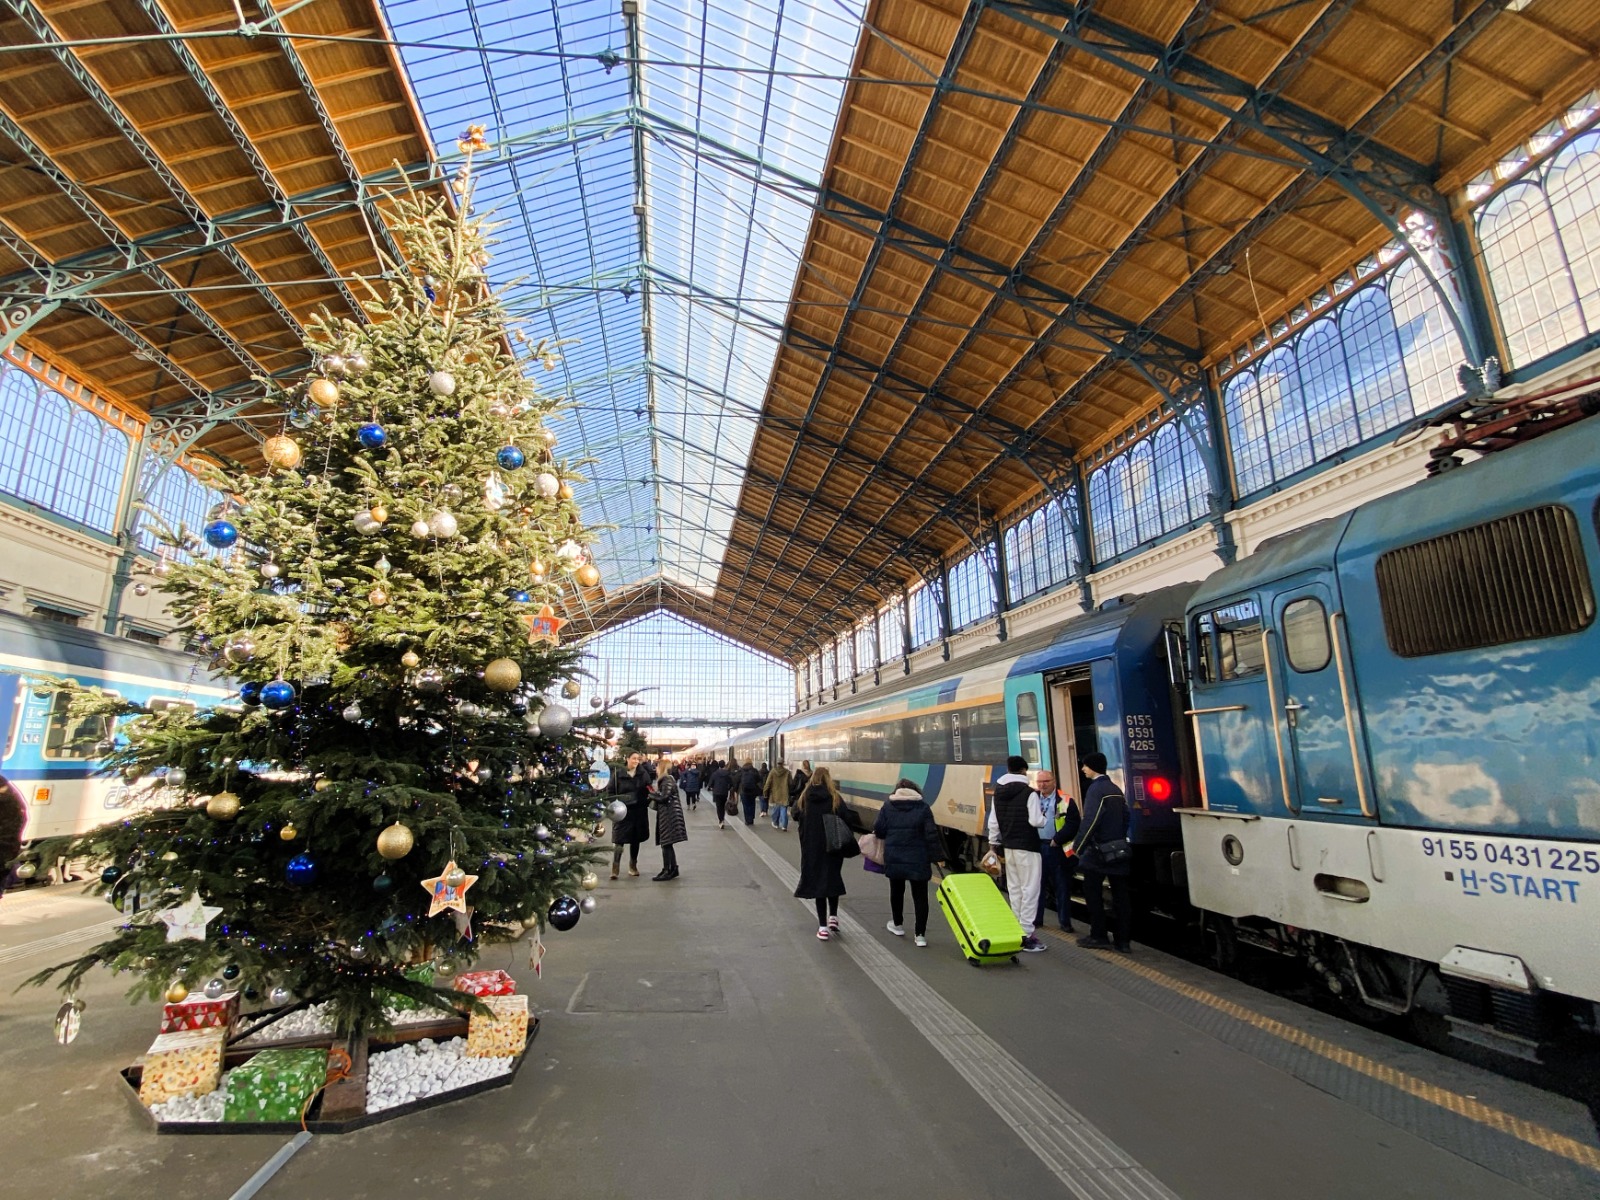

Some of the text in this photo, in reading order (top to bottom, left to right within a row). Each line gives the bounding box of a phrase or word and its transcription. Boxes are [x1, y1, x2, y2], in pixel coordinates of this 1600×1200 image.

[1126, 715, 1152, 726] 6155
[1128, 727, 1154, 738] 8591
[1129, 740, 1155, 751] 4265
[1460, 868, 1580, 903] H-START
